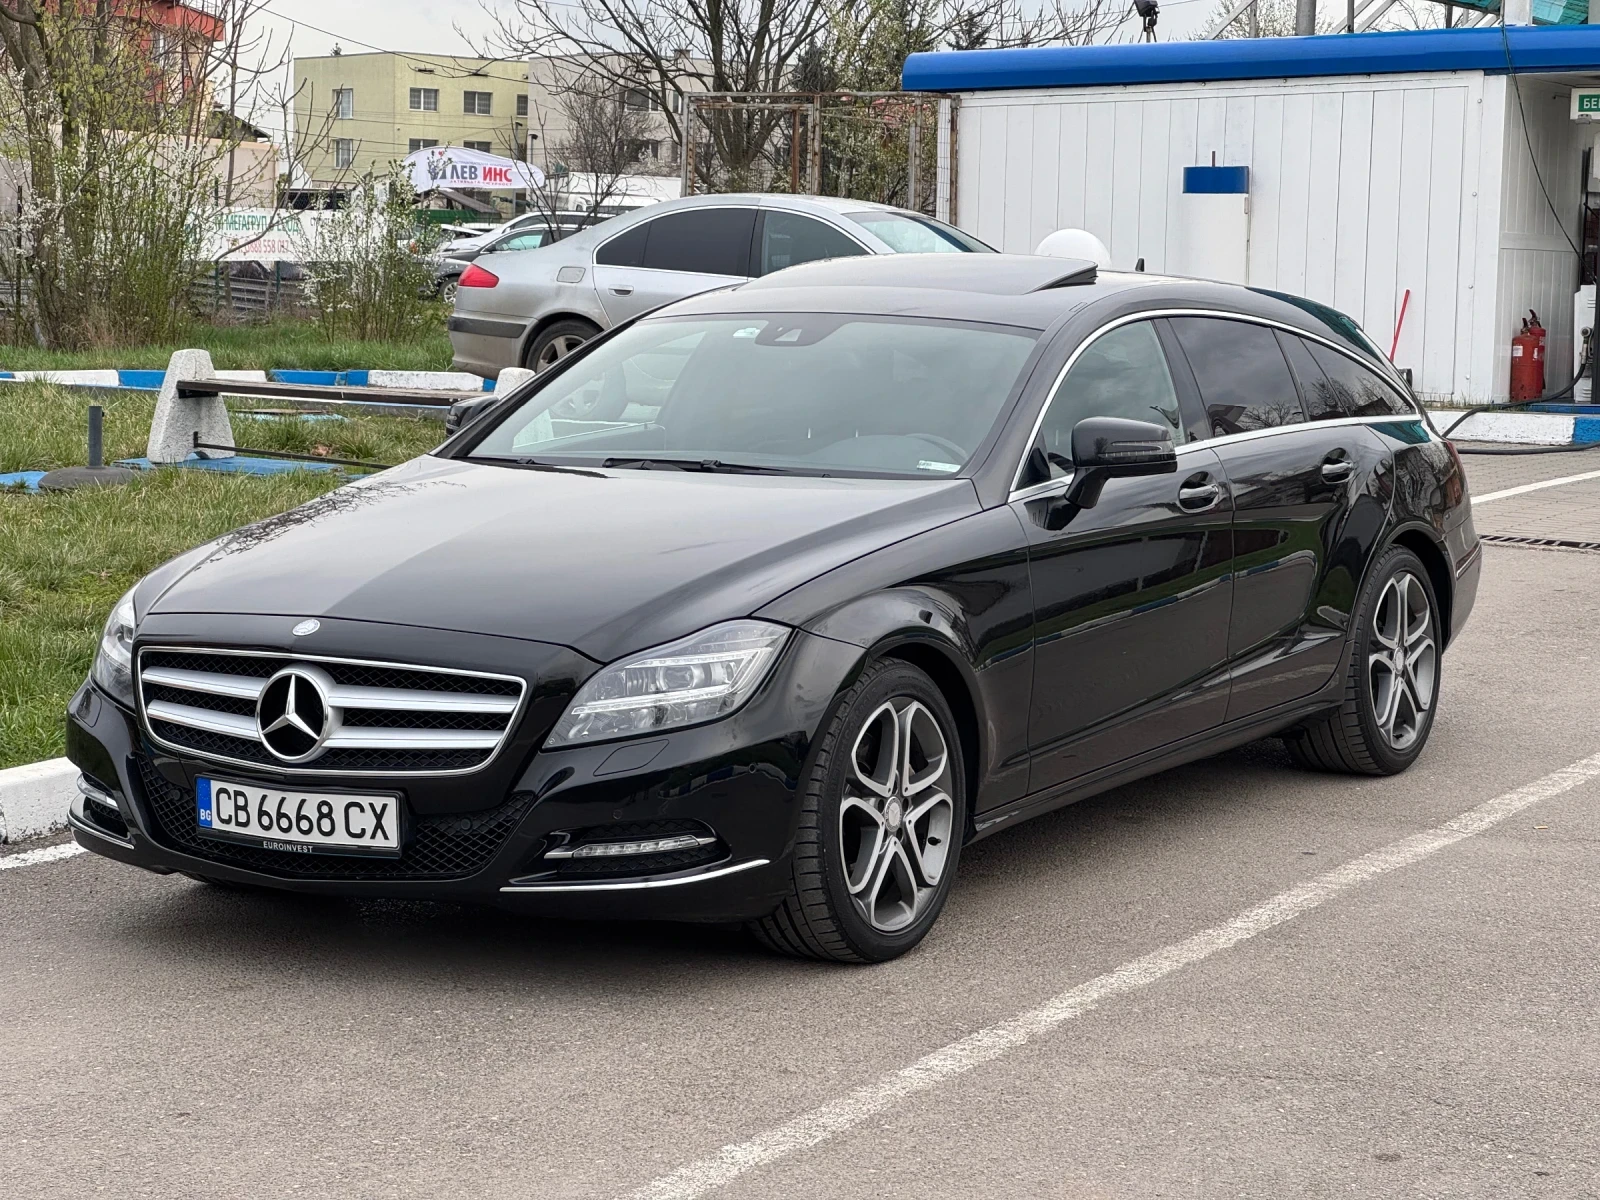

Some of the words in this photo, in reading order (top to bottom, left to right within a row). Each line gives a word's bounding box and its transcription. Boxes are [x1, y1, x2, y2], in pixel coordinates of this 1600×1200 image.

[1583, 98, 1600, 109] БЕ
[450, 164, 478, 180] ЛЕВ
[482, 166, 512, 183] ИНС
[263, 239, 275, 253] 558
[200, 808, 212, 821] BG
[215, 787, 251, 828] CB
[257, 794, 336, 837] 6668
[344, 801, 390, 841] CX
[263, 840, 314, 853] EUROINVEST
